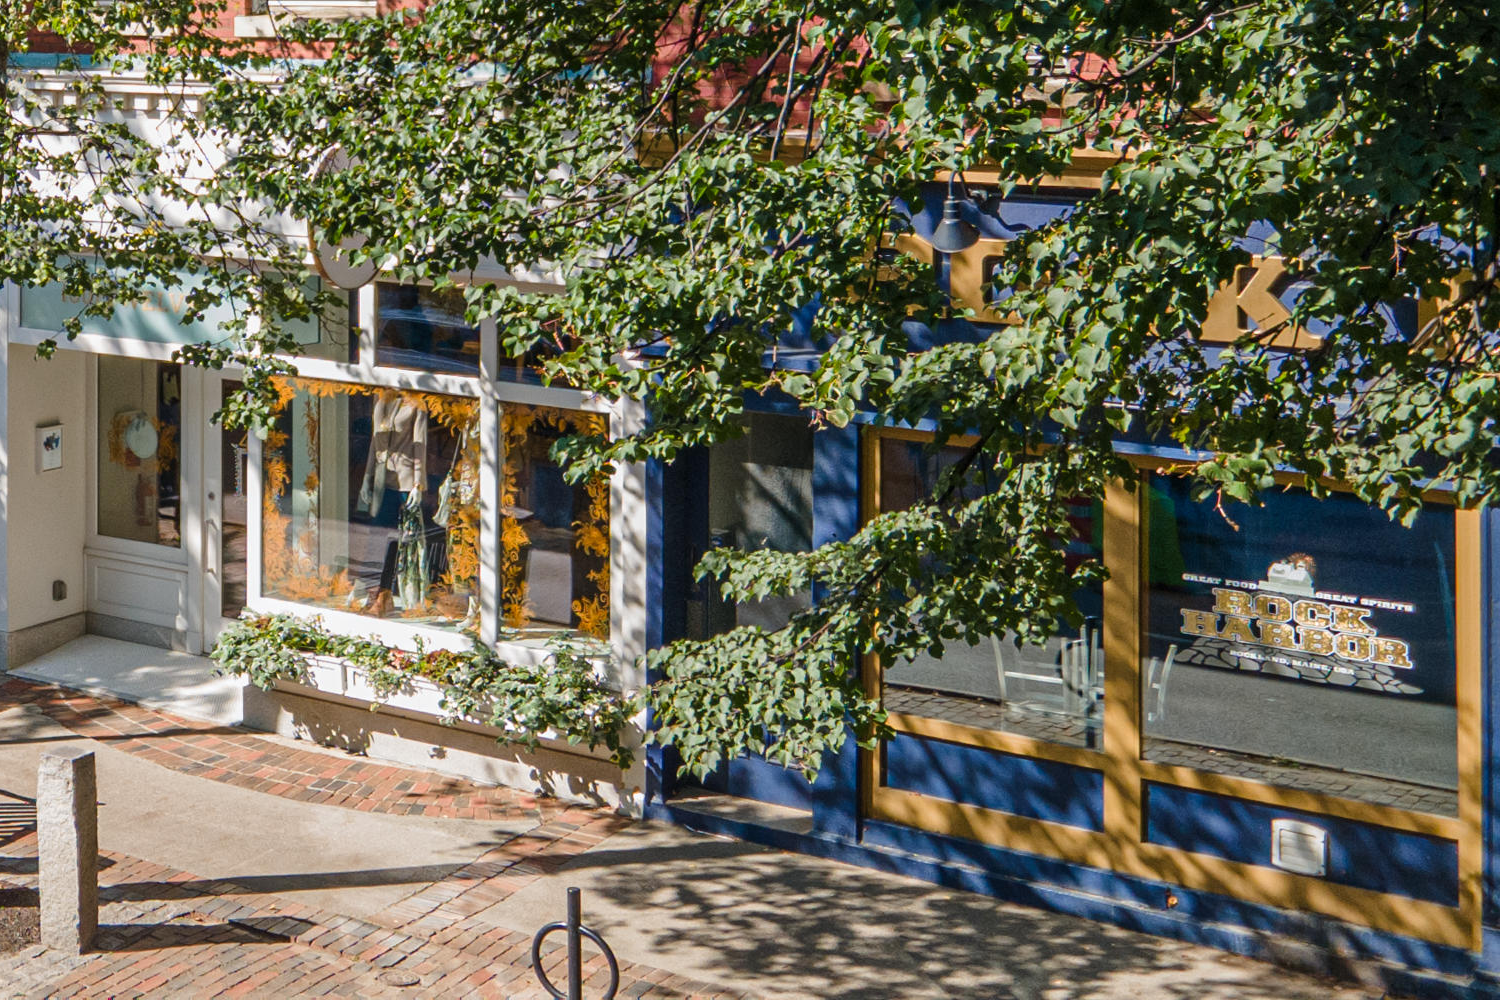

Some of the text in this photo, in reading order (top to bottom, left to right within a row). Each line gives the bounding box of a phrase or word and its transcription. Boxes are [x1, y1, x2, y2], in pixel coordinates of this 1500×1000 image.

[1182, 573, 1221, 585] GREAT
[1212, 587, 1377, 637] ROCK
[1315, 591, 1414, 612] GREAT SPIRITS
[1180, 607, 1413, 669] HARBOR
